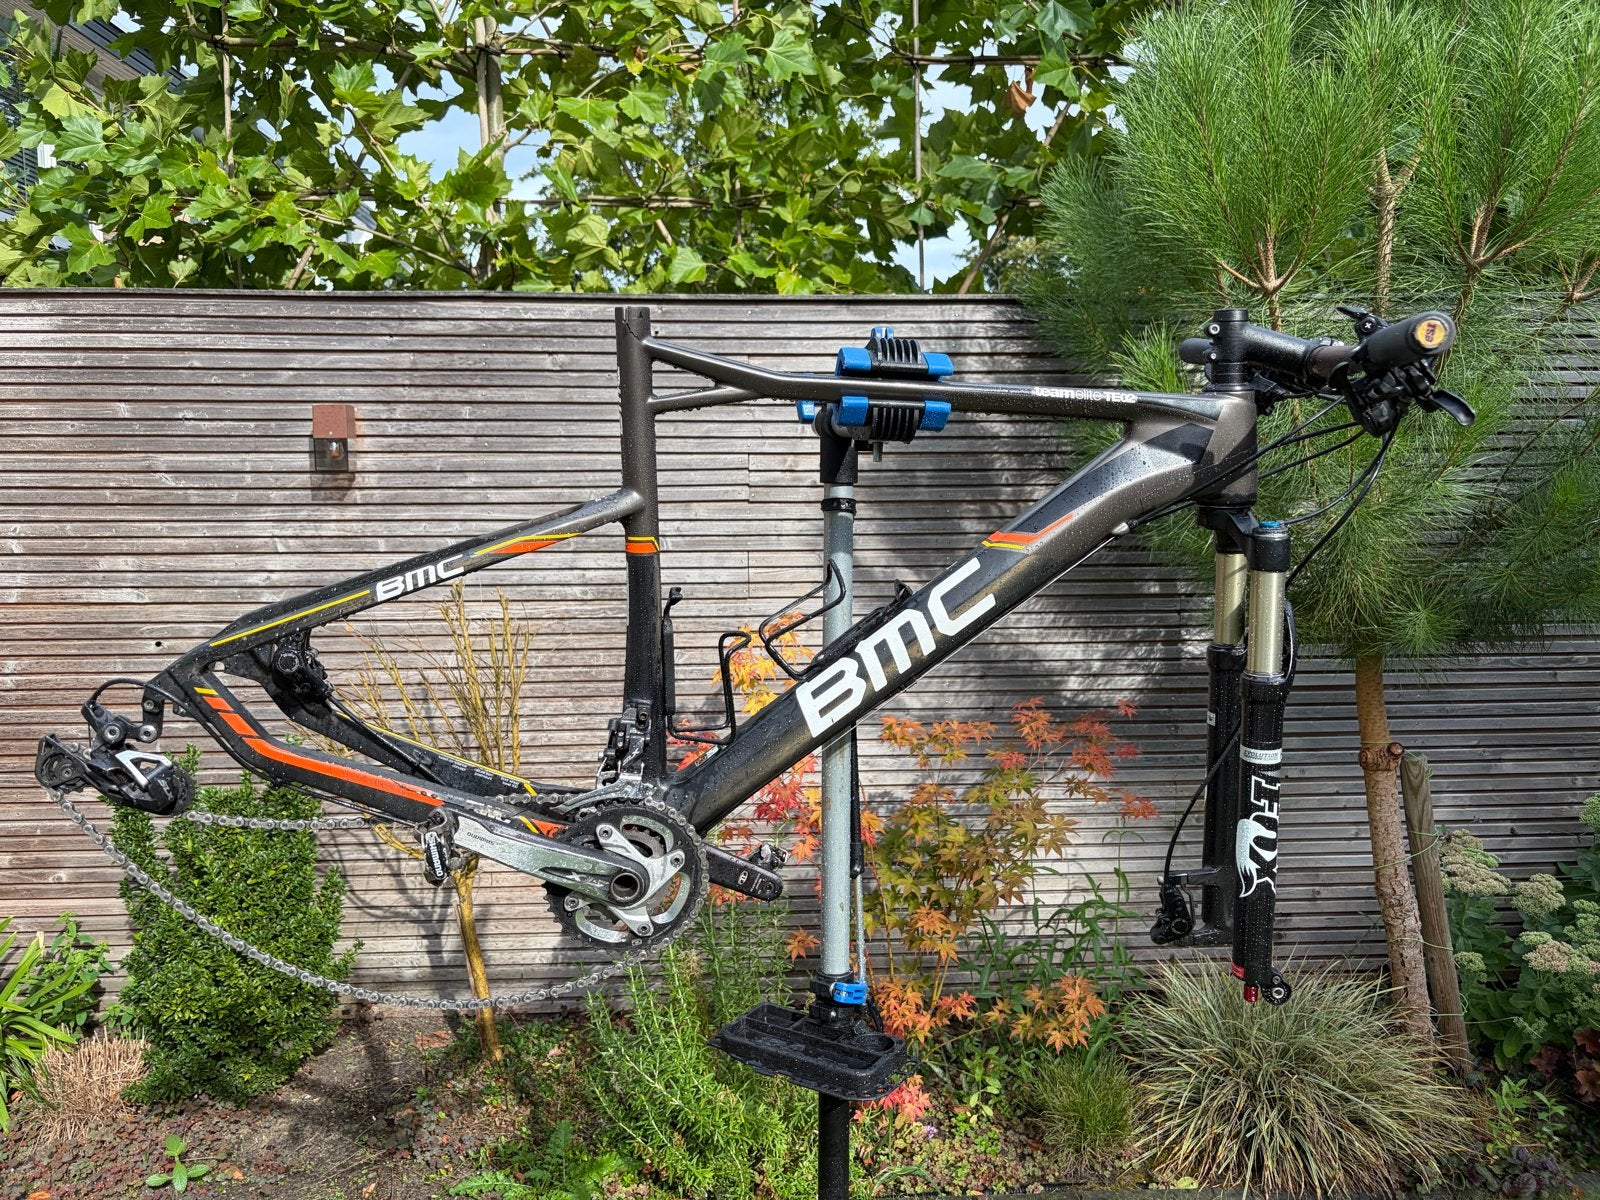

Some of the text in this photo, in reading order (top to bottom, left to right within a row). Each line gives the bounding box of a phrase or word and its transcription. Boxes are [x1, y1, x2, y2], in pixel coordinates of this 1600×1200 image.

[1103, 391, 1138, 403] TE02
[376, 554, 464, 602] BMC
[796, 557, 996, 738] BMC
[428, 836, 444, 877] SHIMANO
